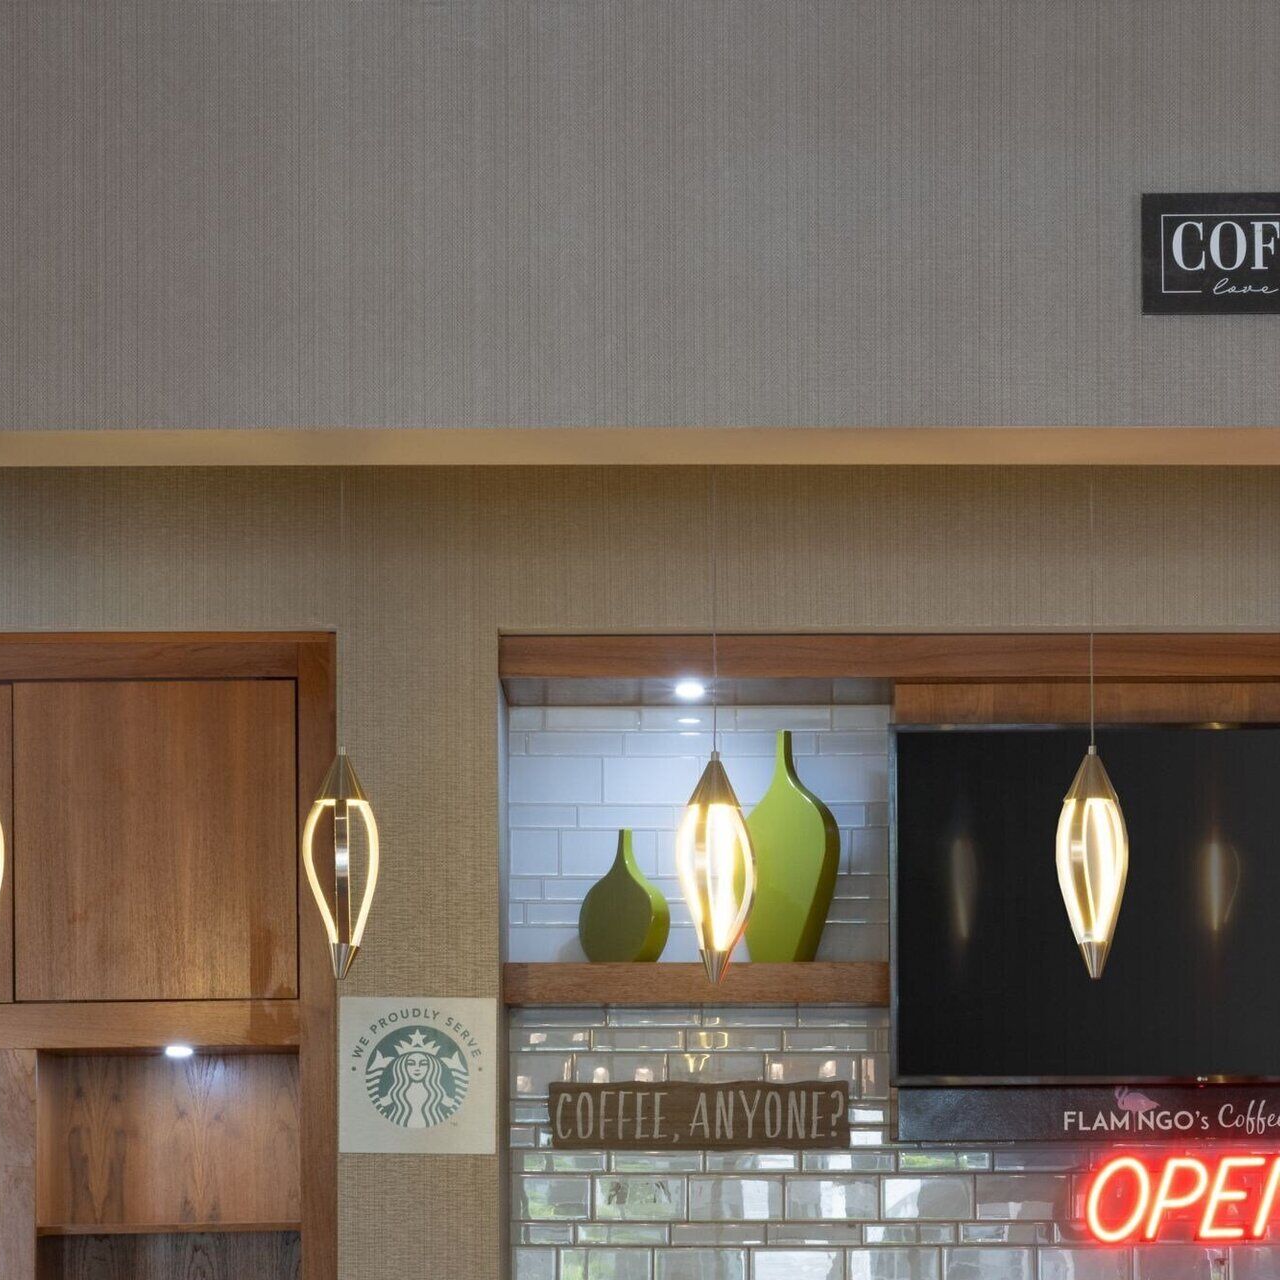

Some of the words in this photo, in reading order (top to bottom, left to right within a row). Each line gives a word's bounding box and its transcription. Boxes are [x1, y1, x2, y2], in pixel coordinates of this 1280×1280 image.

[1213, 277, 1279, 295] love
[352, 1036, 370, 1058] WE
[370, 1008, 440, 1035] PROUDLY
[445, 1017, 482, 1058] SERVE
[556, 1091, 680, 1143] COFFEE,
[689, 1089, 844, 1139] ANYONE?
